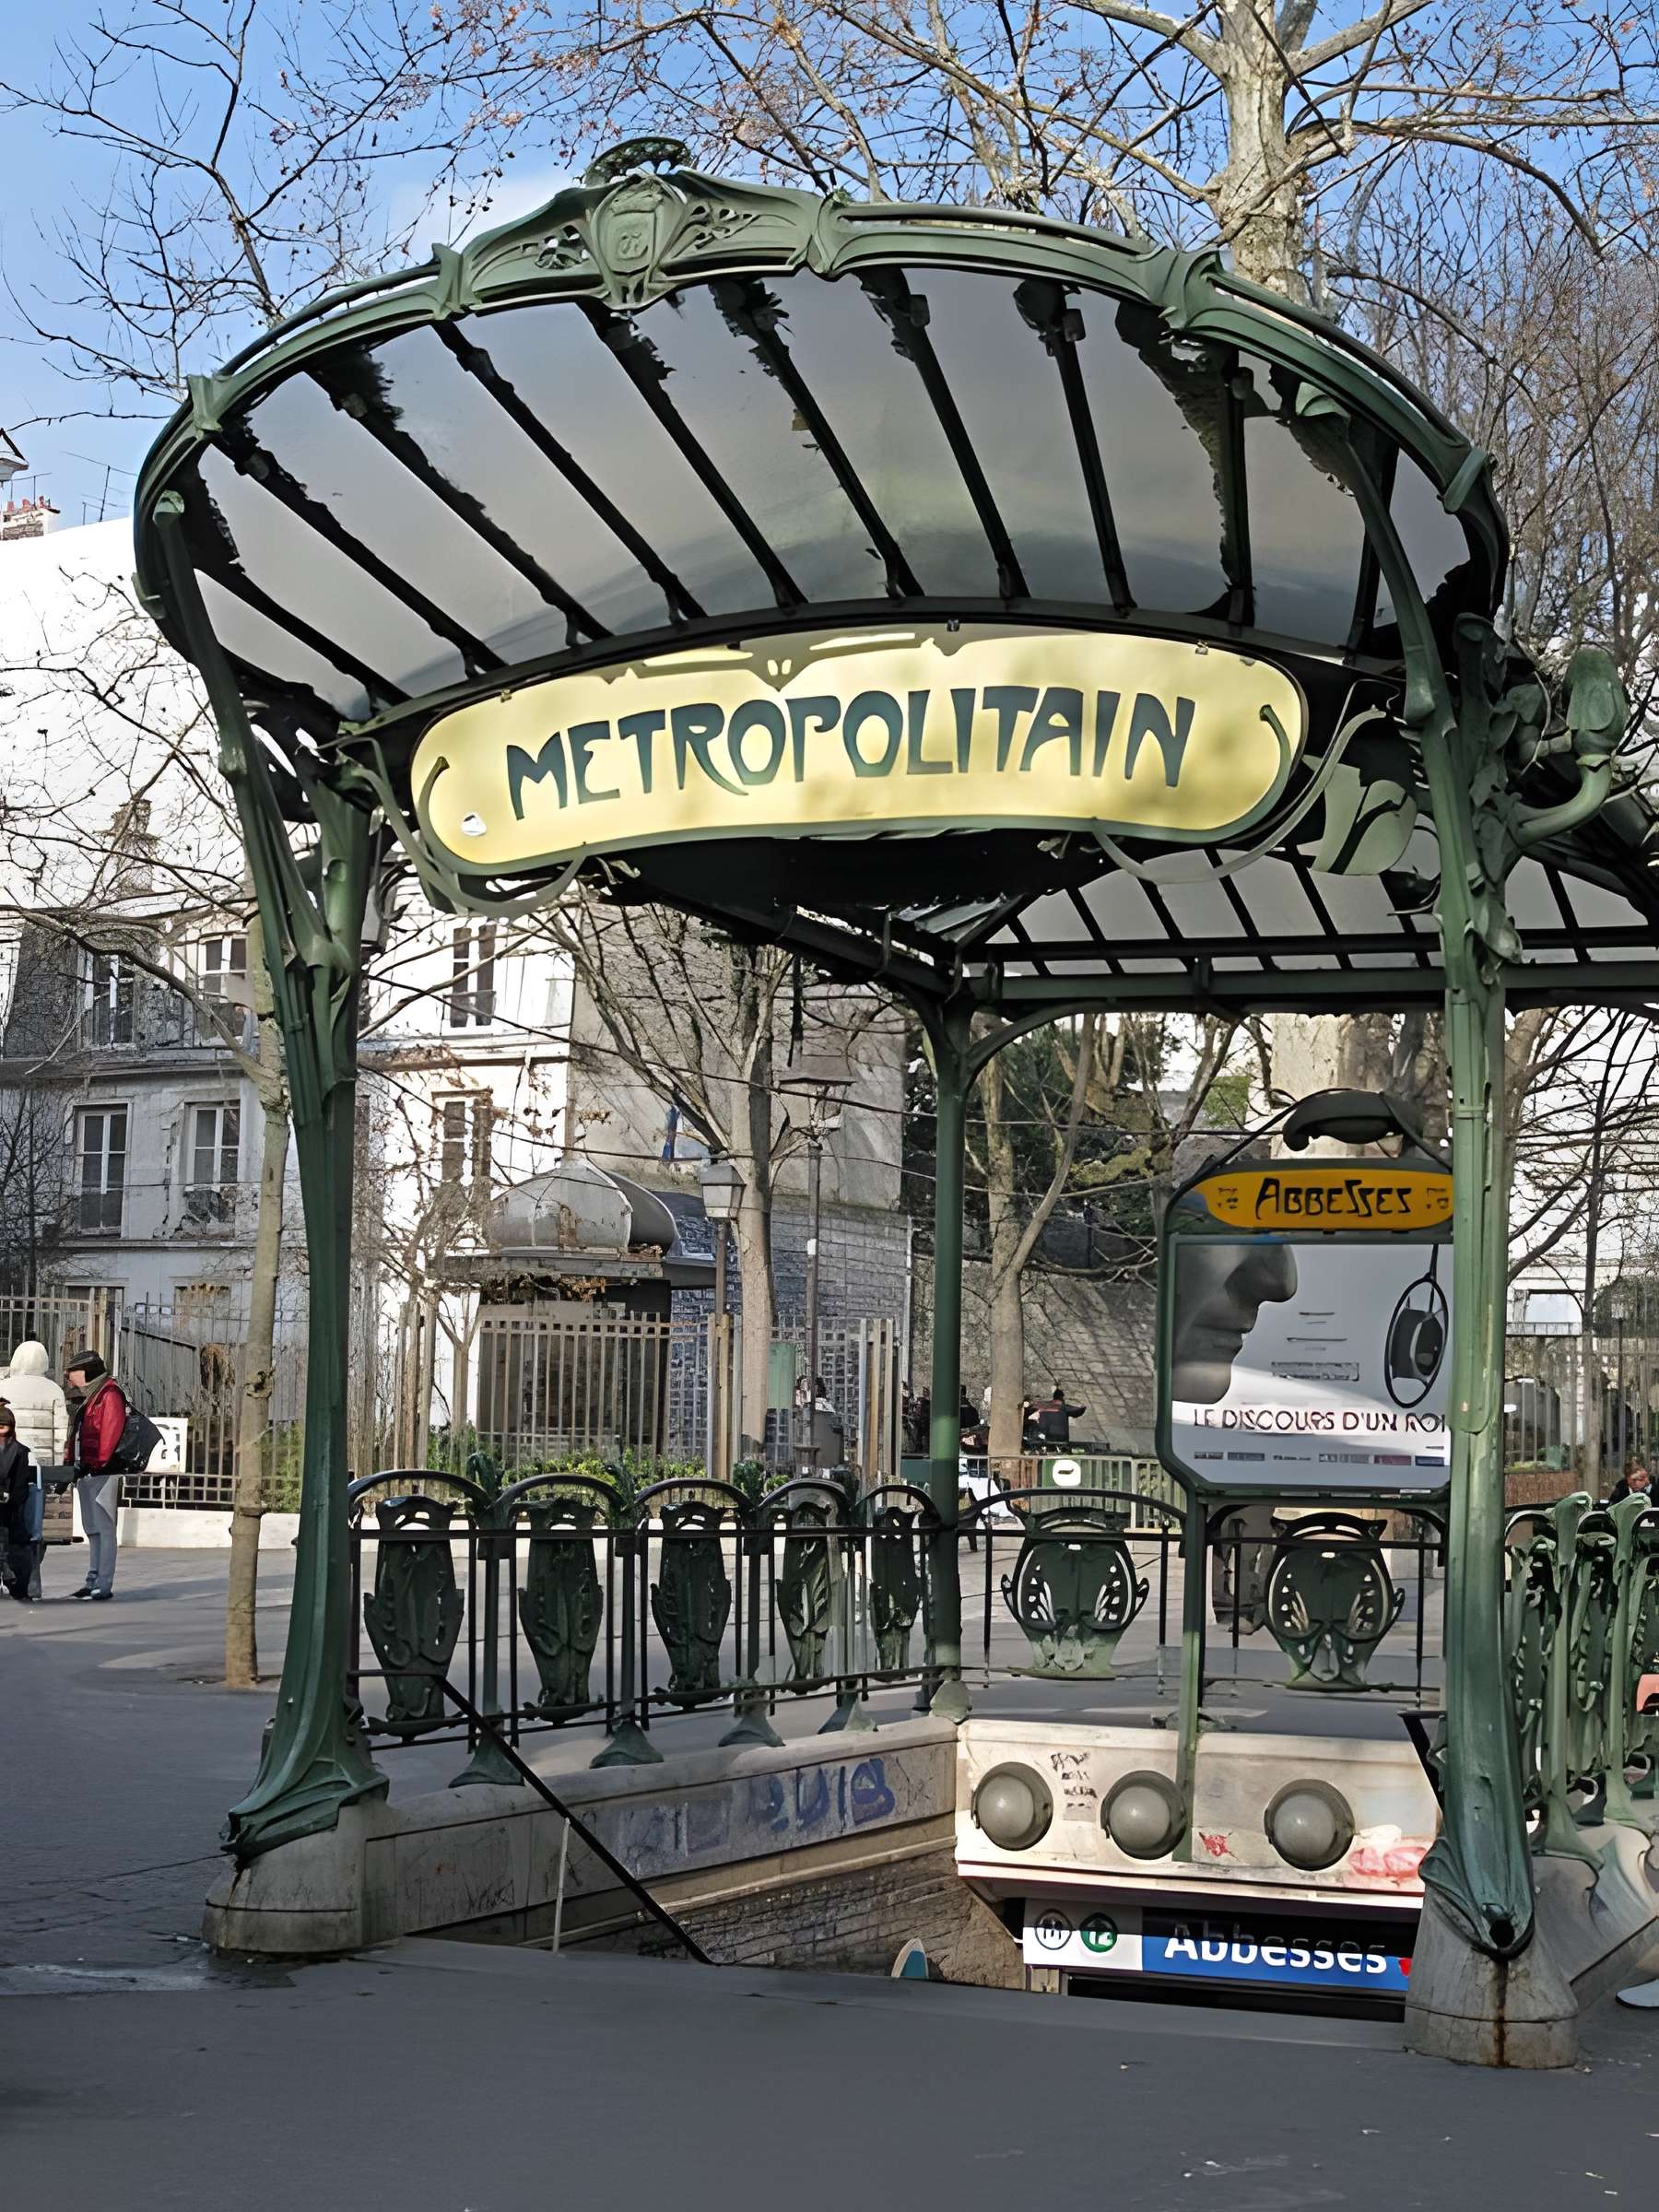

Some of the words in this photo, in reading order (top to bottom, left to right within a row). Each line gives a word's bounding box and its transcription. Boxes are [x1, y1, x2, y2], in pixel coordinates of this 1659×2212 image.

[506, 685, 1196, 820] METROPOLITAIN
[1194, 1408, 1215, 1428] LE
[1222, 1409, 1335, 1431] DISCOURS
[1342, 1411, 1397, 1432] D'UN
[1405, 1412, 1446, 1434] ROI
[1164, 1920, 1387, 1974] Abbesses
